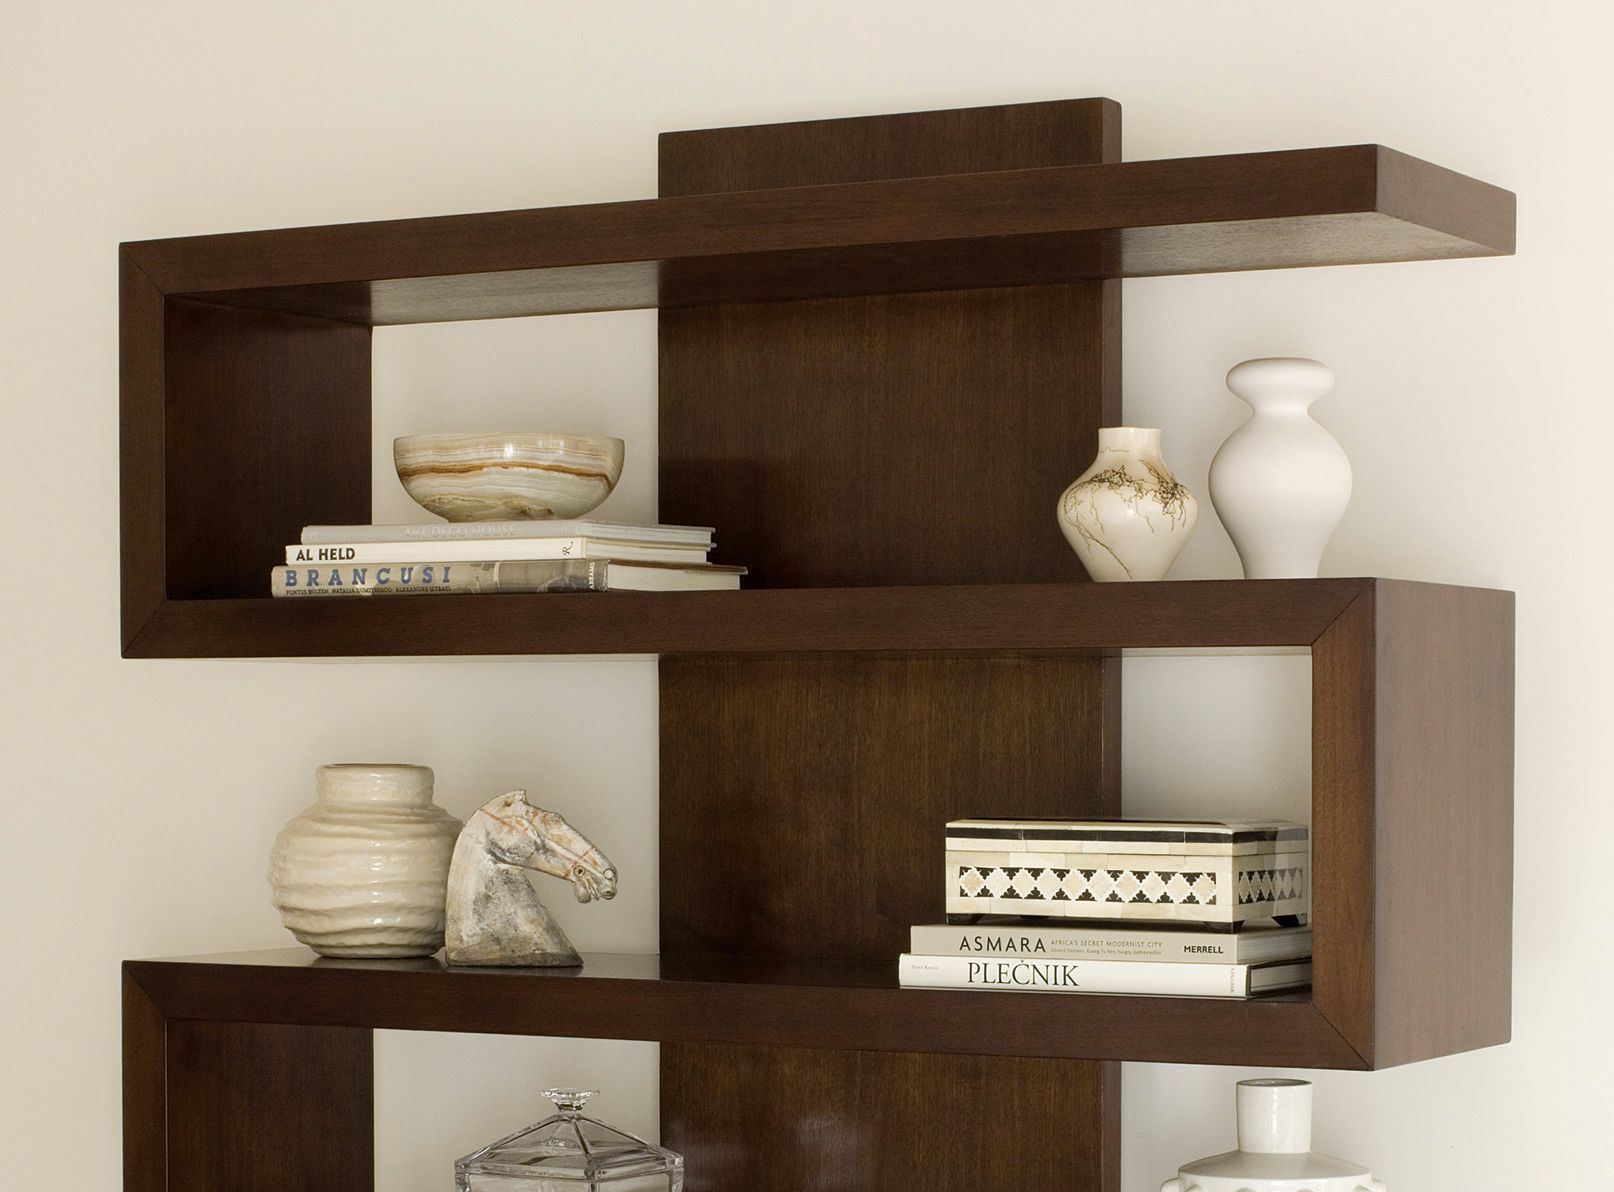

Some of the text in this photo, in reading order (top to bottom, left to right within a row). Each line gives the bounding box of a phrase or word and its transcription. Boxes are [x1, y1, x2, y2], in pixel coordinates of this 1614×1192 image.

[296, 548, 356, 561] AL HELD
[285, 566, 451, 587] BRANCUSI
[959, 936, 1046, 953] ASMARA
[1147, 941, 1163, 949] CITY
[1184, 946, 1224, 954] MERRELL
[967, 959, 1080, 986] PLEČNIK
